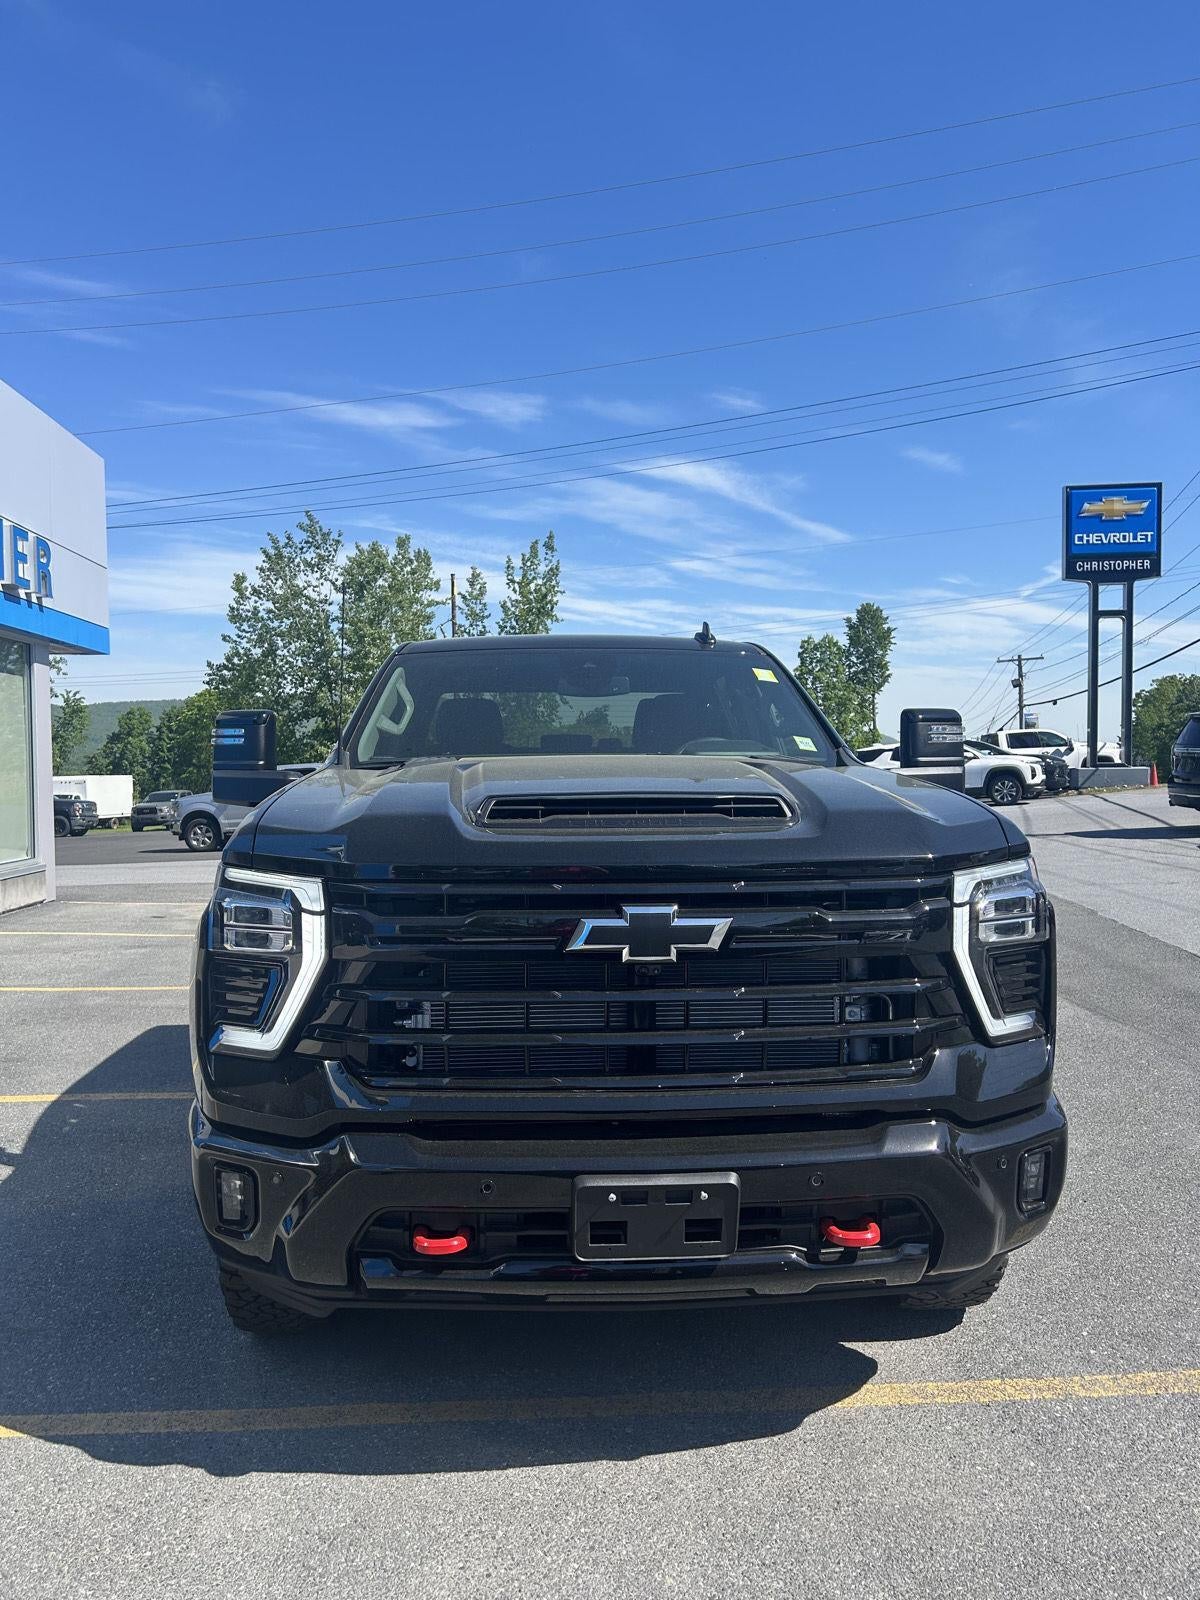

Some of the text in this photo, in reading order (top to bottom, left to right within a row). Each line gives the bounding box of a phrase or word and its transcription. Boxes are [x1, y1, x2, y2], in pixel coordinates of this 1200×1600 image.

[1074, 531, 1154, 544] CHEVROLET
[0, 518, 53, 599] ER
[1076, 559, 1151, 572] CHRISTOPHER
